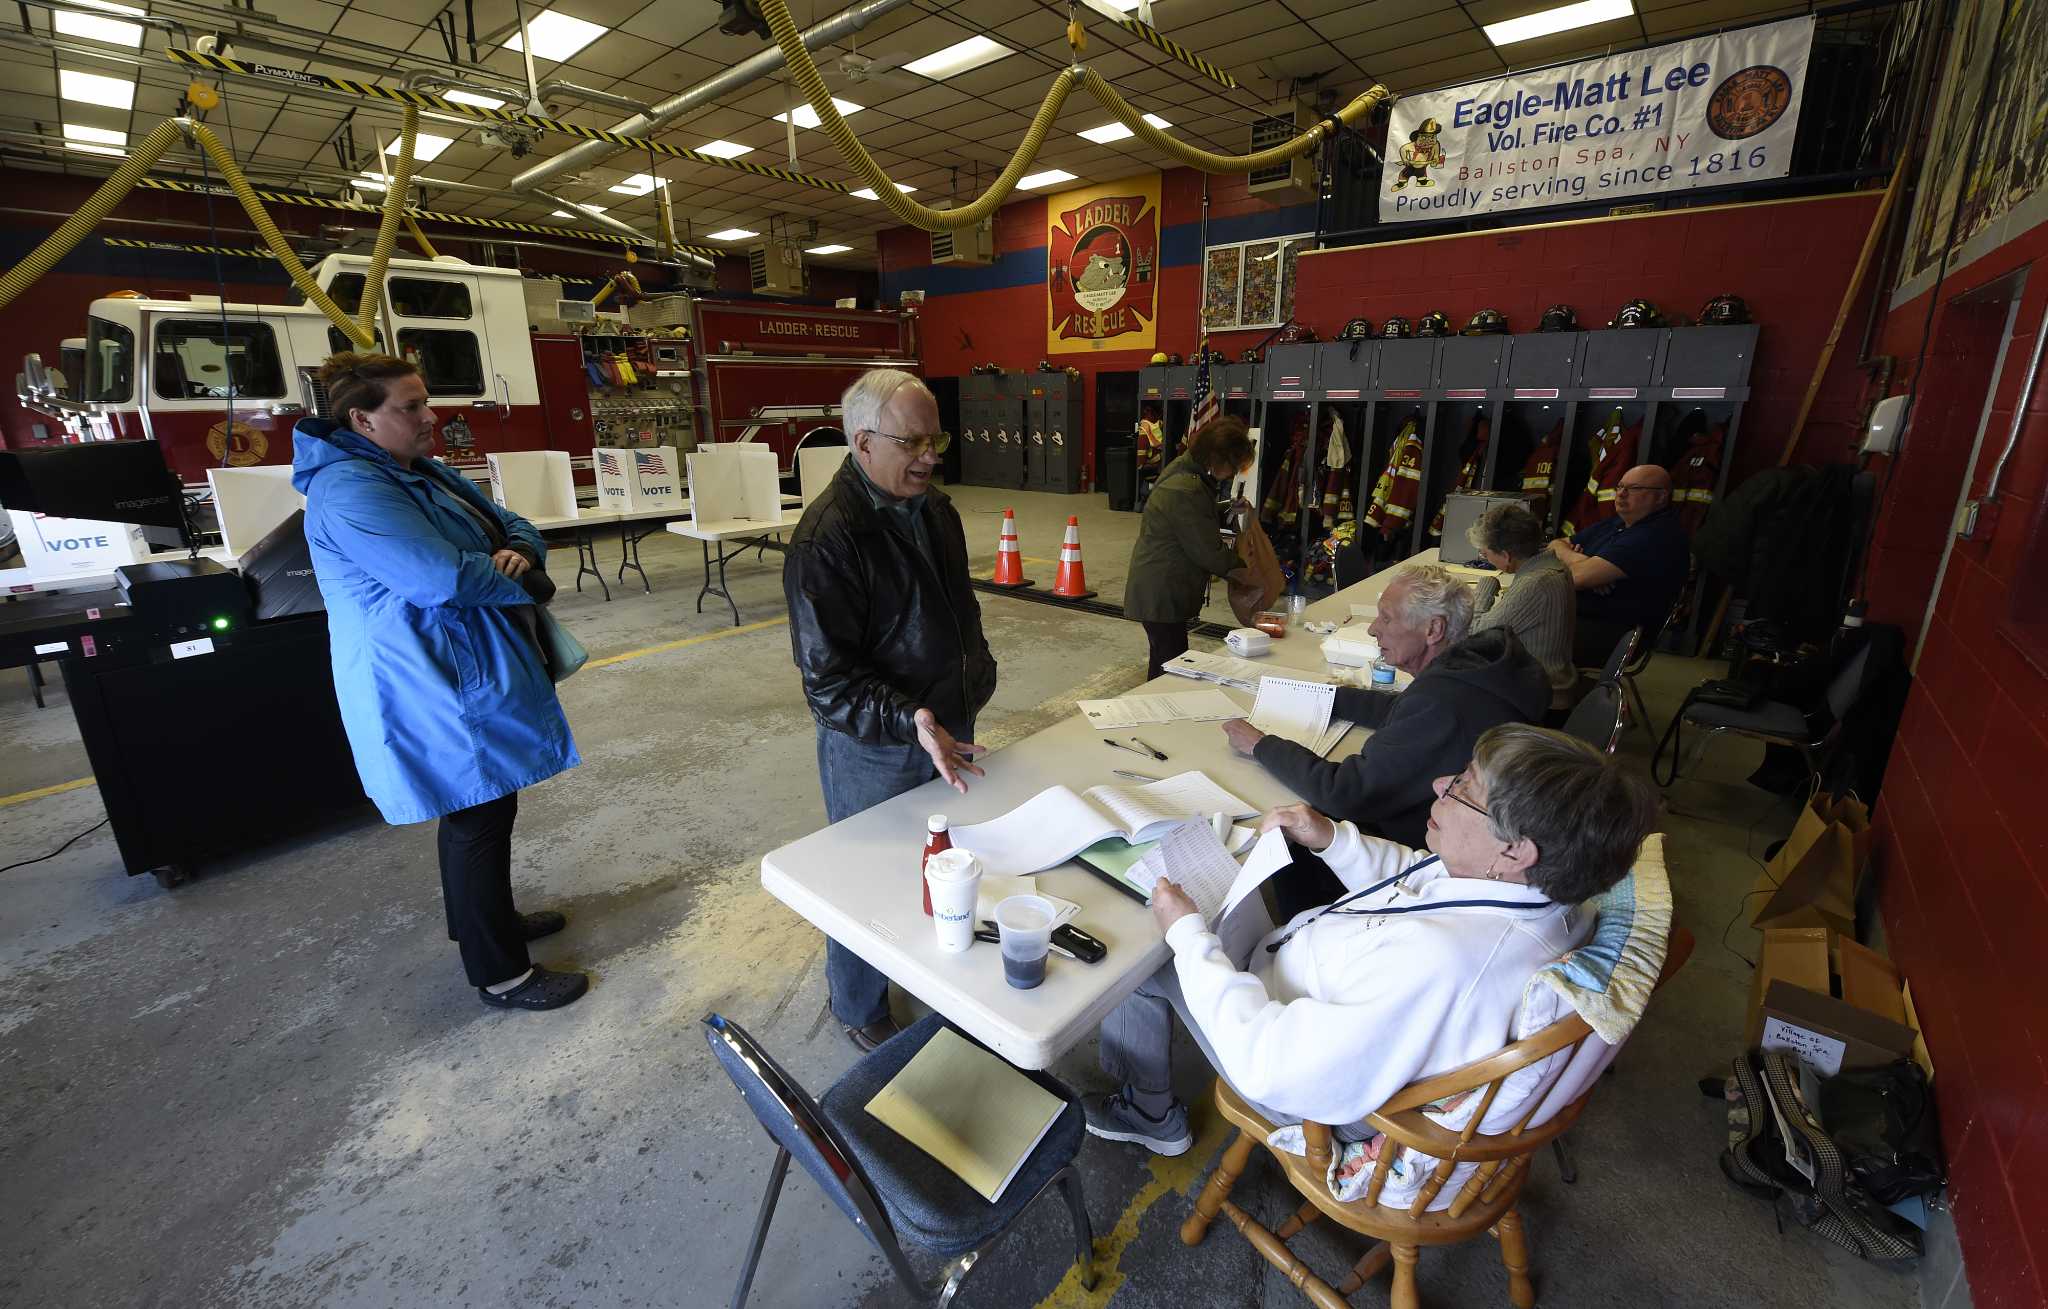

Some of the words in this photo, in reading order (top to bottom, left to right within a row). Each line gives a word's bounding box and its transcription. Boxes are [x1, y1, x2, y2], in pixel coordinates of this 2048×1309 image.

[1453, 71, 1631, 129] Eagle-Matt
[1641, 62, 1711, 96] Lee
[1488, 127, 1526, 153] Vol.
[1533, 122, 1578, 146] Fire
[1585, 113, 1625, 138] Co.
[1633, 102, 1664, 130] #1
[1458, 156, 1560, 181] Ballston
[1576, 147, 1635, 166] Spa,
[1655, 132, 1691, 153] NY
[1396, 188, 1483, 213] Proudly
[1492, 175, 1586, 203] serving
[1598, 165, 1673, 189] since
[1687, 146, 1766, 177] 1816
[1074, 203, 1131, 235] LADDER
[760, 321, 809, 336] LADDER
[815, 323, 860, 338] RESCUE
[1353, 325, 1366, 334] 35
[1401, 455, 1416, 468] 34
[604, 487, 625, 497] VOTE
[642, 486, 672, 496] VOTE
[46, 535, 109, 552] VOTE
